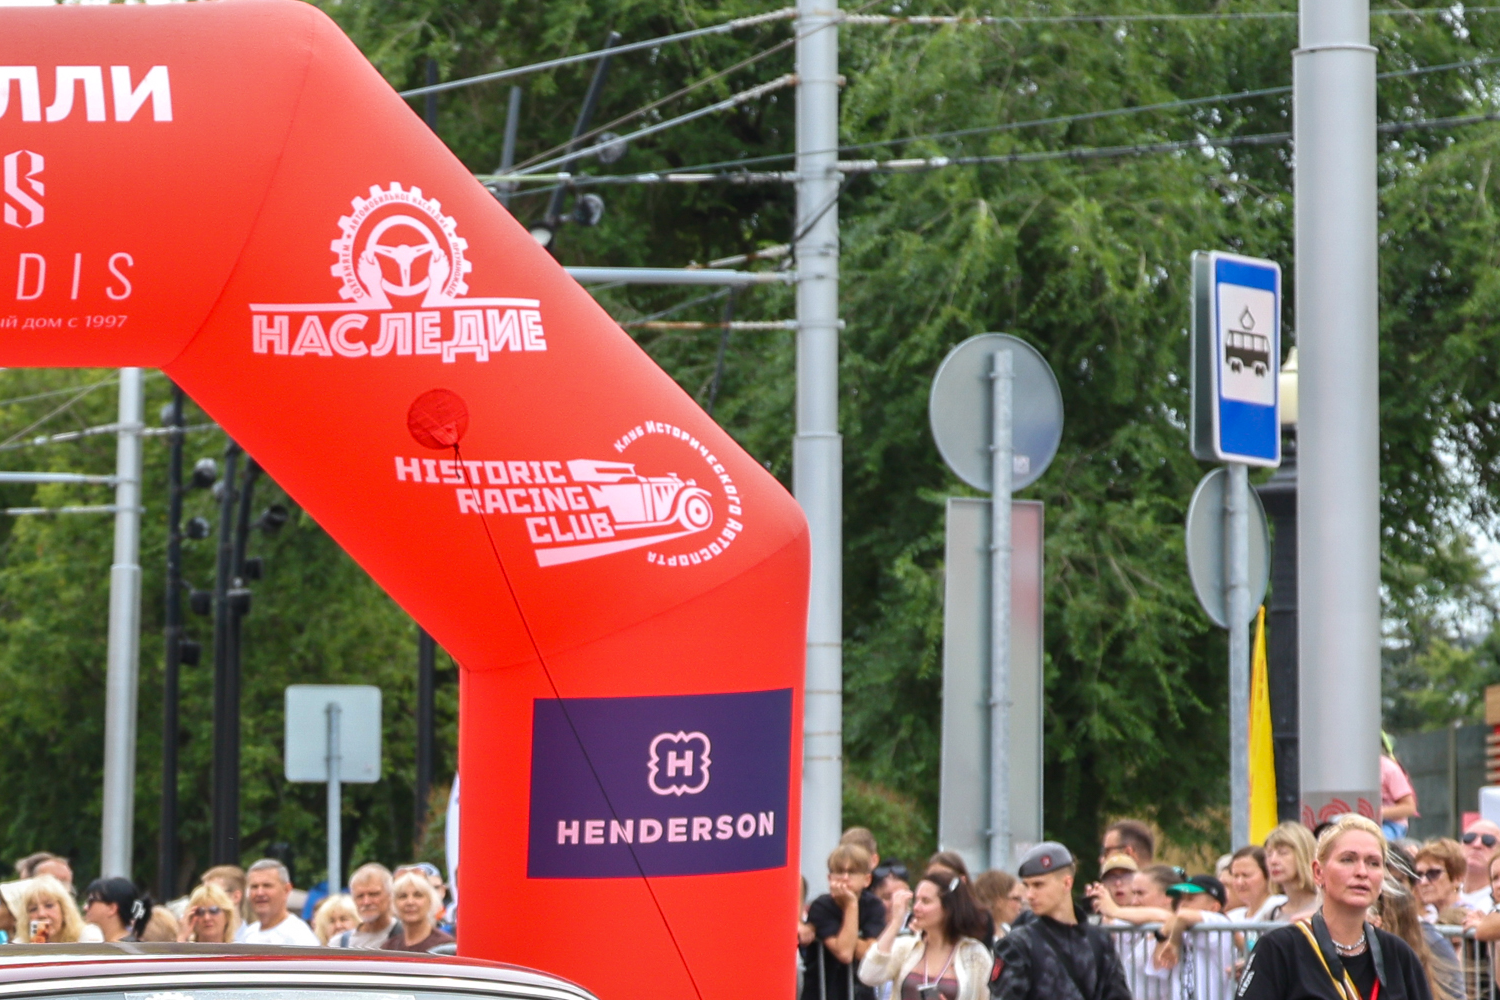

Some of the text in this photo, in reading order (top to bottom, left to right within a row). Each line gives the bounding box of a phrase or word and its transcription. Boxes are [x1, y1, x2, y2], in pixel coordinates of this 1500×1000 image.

[350, 192, 410, 232] АВТОМОБИЛЬНОЕ
[412, 196, 449, 229] НАСЛЕДИЕ
[341, 244, 365, 299] СОХРАНЯЕМ
[22, 316, 63, 330] дом
[67, 317, 78, 329] с
[85, 315, 128, 329] 1997
[252, 309, 548, 363] НАСЛЕДИЕ
[394, 456, 567, 484] HISTORIC
[456, 485, 592, 514] RACING
[525, 513, 615, 543] CLUB
[667, 750, 693, 777] H
[557, 811, 775, 846] HENDERSON
